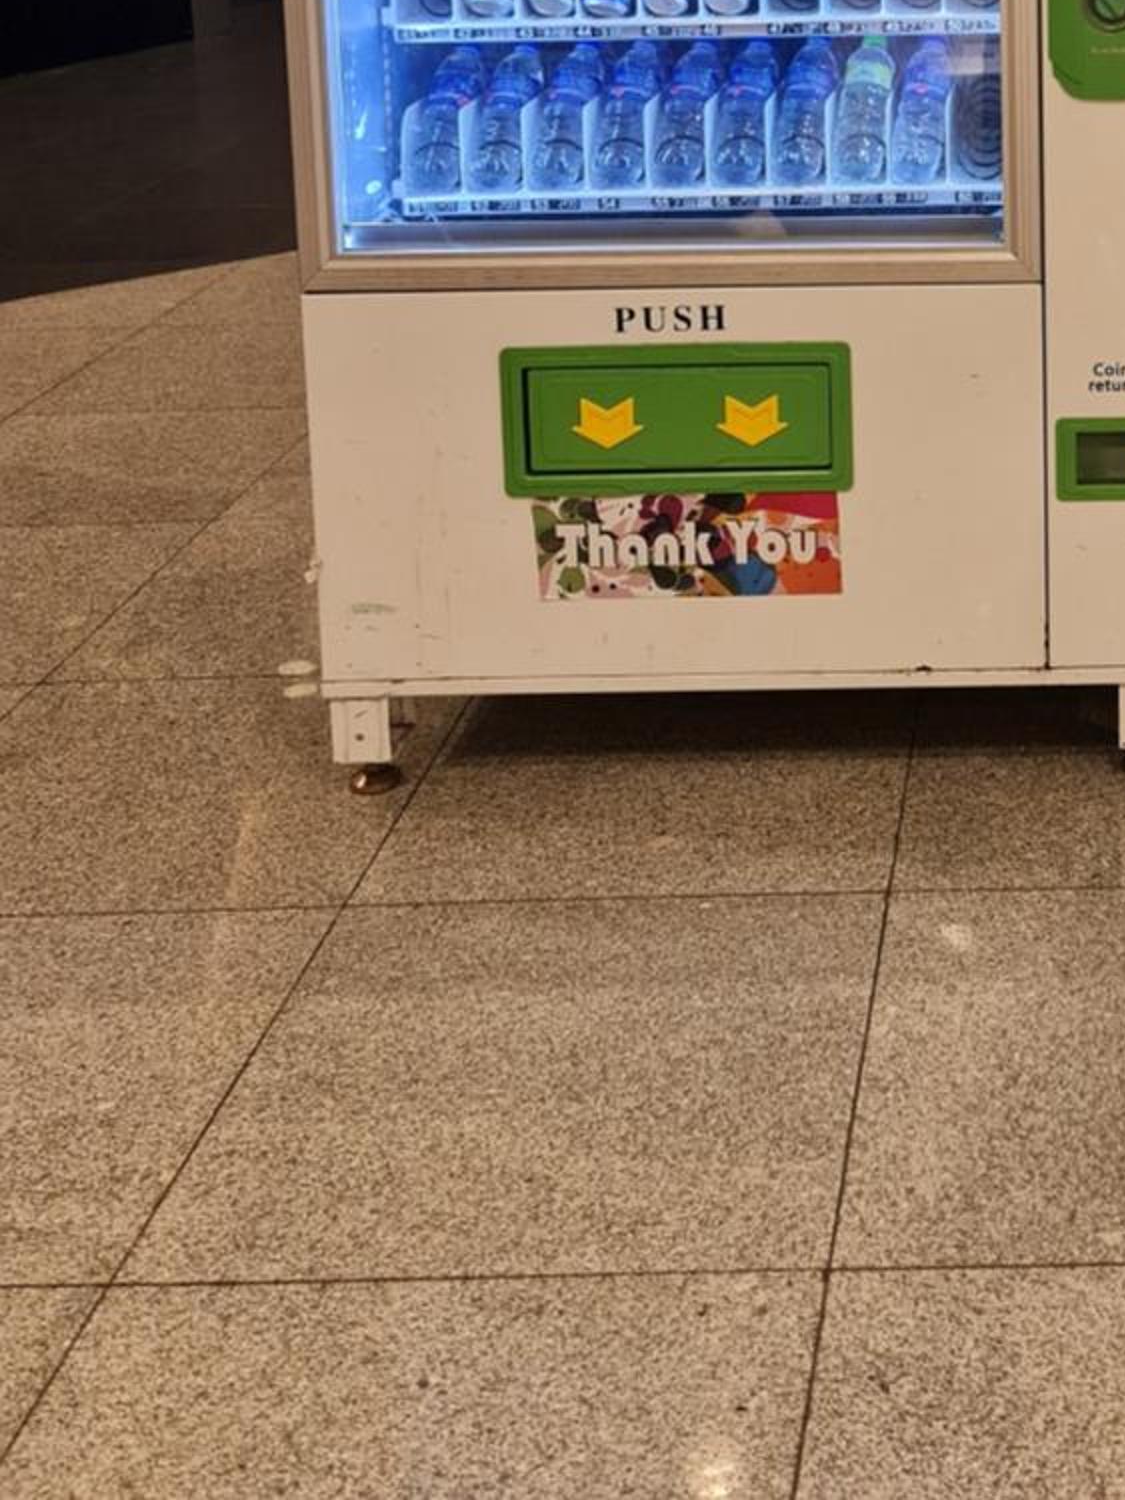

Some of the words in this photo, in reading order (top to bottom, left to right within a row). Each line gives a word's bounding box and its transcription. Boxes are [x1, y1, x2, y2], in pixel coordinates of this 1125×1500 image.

[614, 304, 727, 333] PUSH
[554, 520, 716, 568] Thank
[729, 517, 818, 565] You
